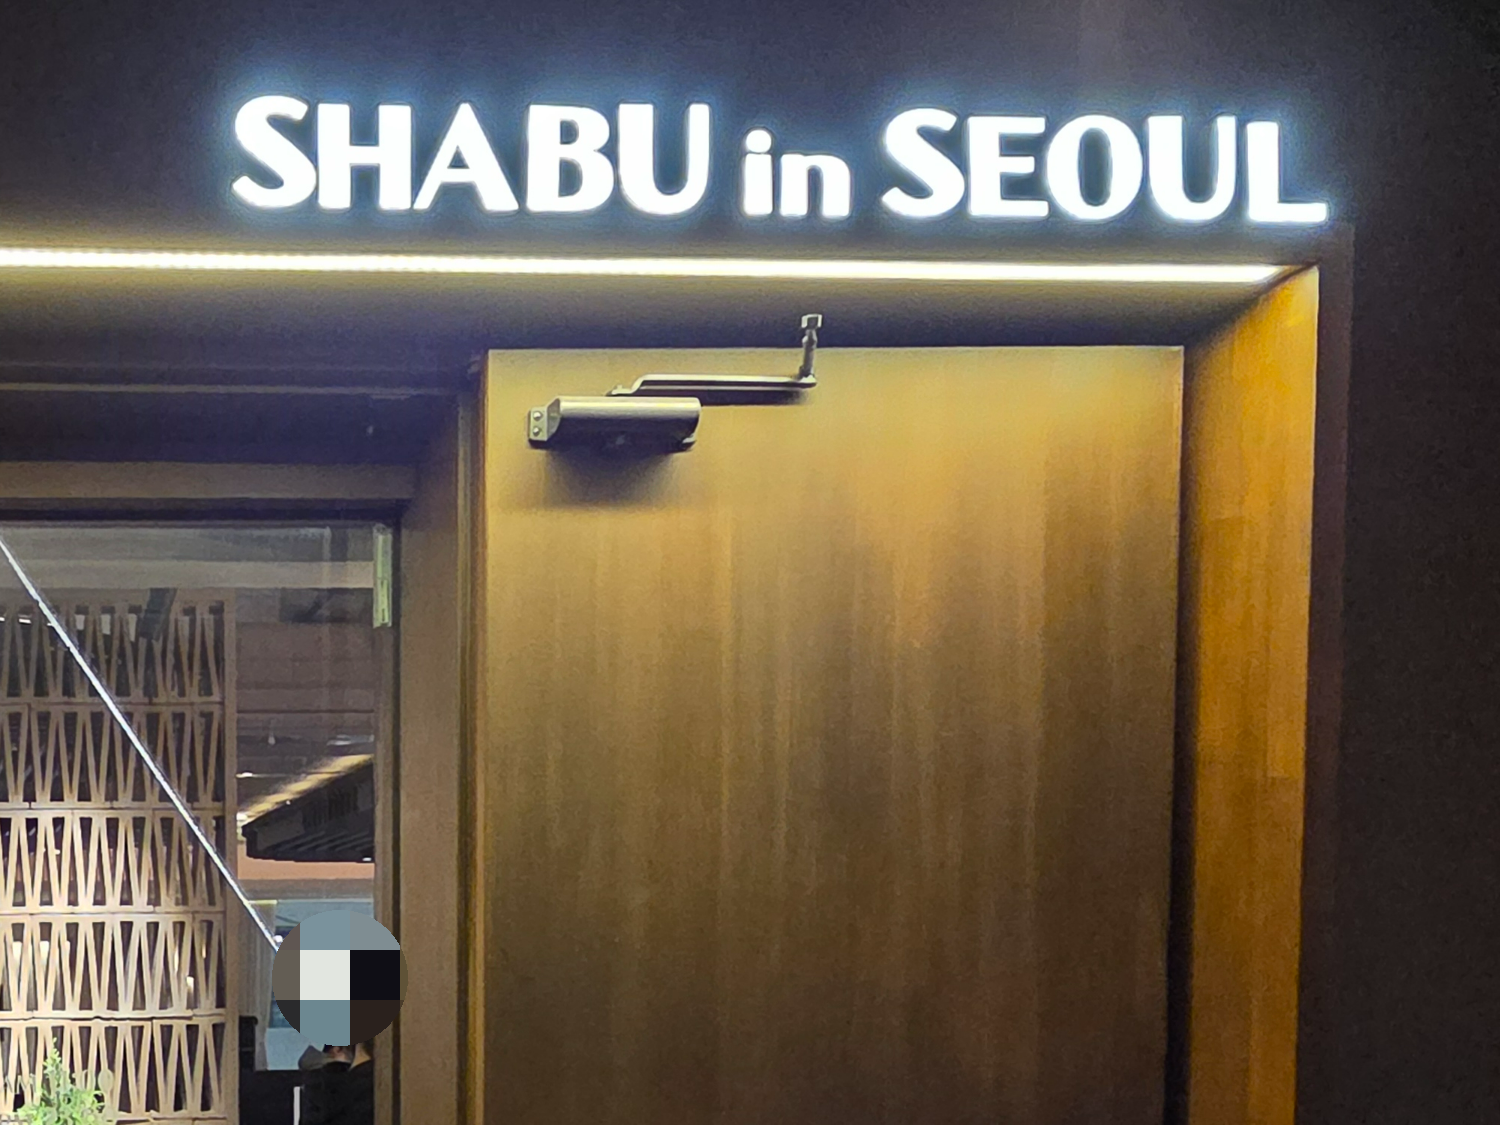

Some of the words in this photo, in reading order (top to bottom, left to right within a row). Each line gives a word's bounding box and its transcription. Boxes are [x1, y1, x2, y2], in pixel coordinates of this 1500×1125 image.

[231, 94, 711, 216] SHABU
[742, 128, 852, 218] in
[881, 107, 1329, 224] SEOUL
